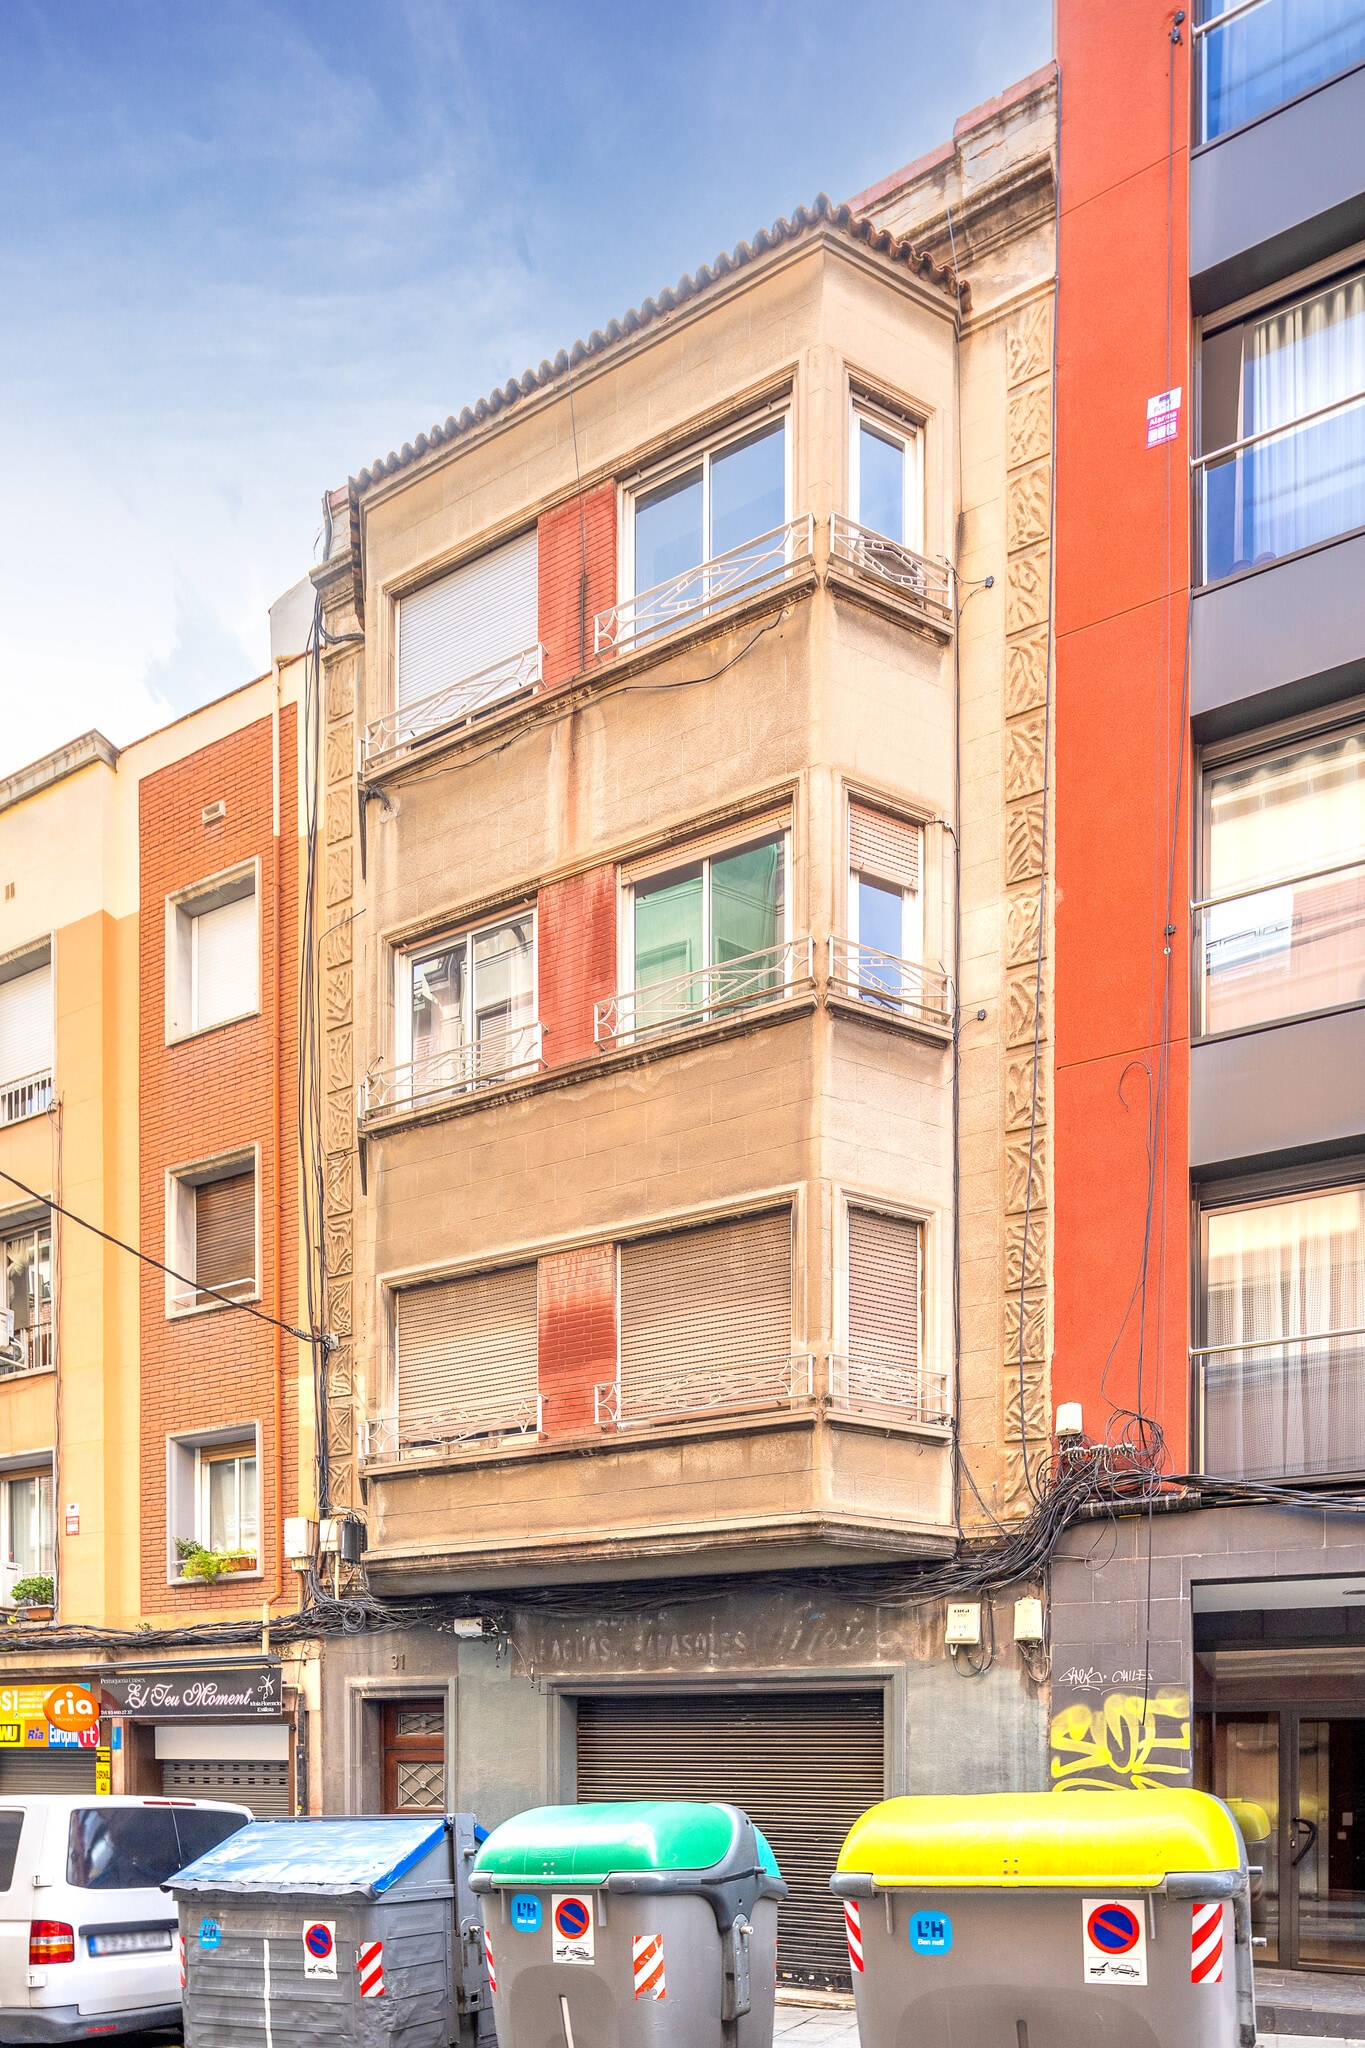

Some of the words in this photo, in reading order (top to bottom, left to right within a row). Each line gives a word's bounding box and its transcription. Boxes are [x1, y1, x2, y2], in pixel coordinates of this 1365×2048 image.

[391, 1653, 406, 1670] 31
[54, 1691, 94, 1715] ria
[125, 1683, 150, 1708] El
[151, 1683, 180, 1706] Teu
[182, 1682, 254, 1706] Moment
[27, 1726, 44, 1740] Ria
[917, 1920, 944, 1937] L'H
